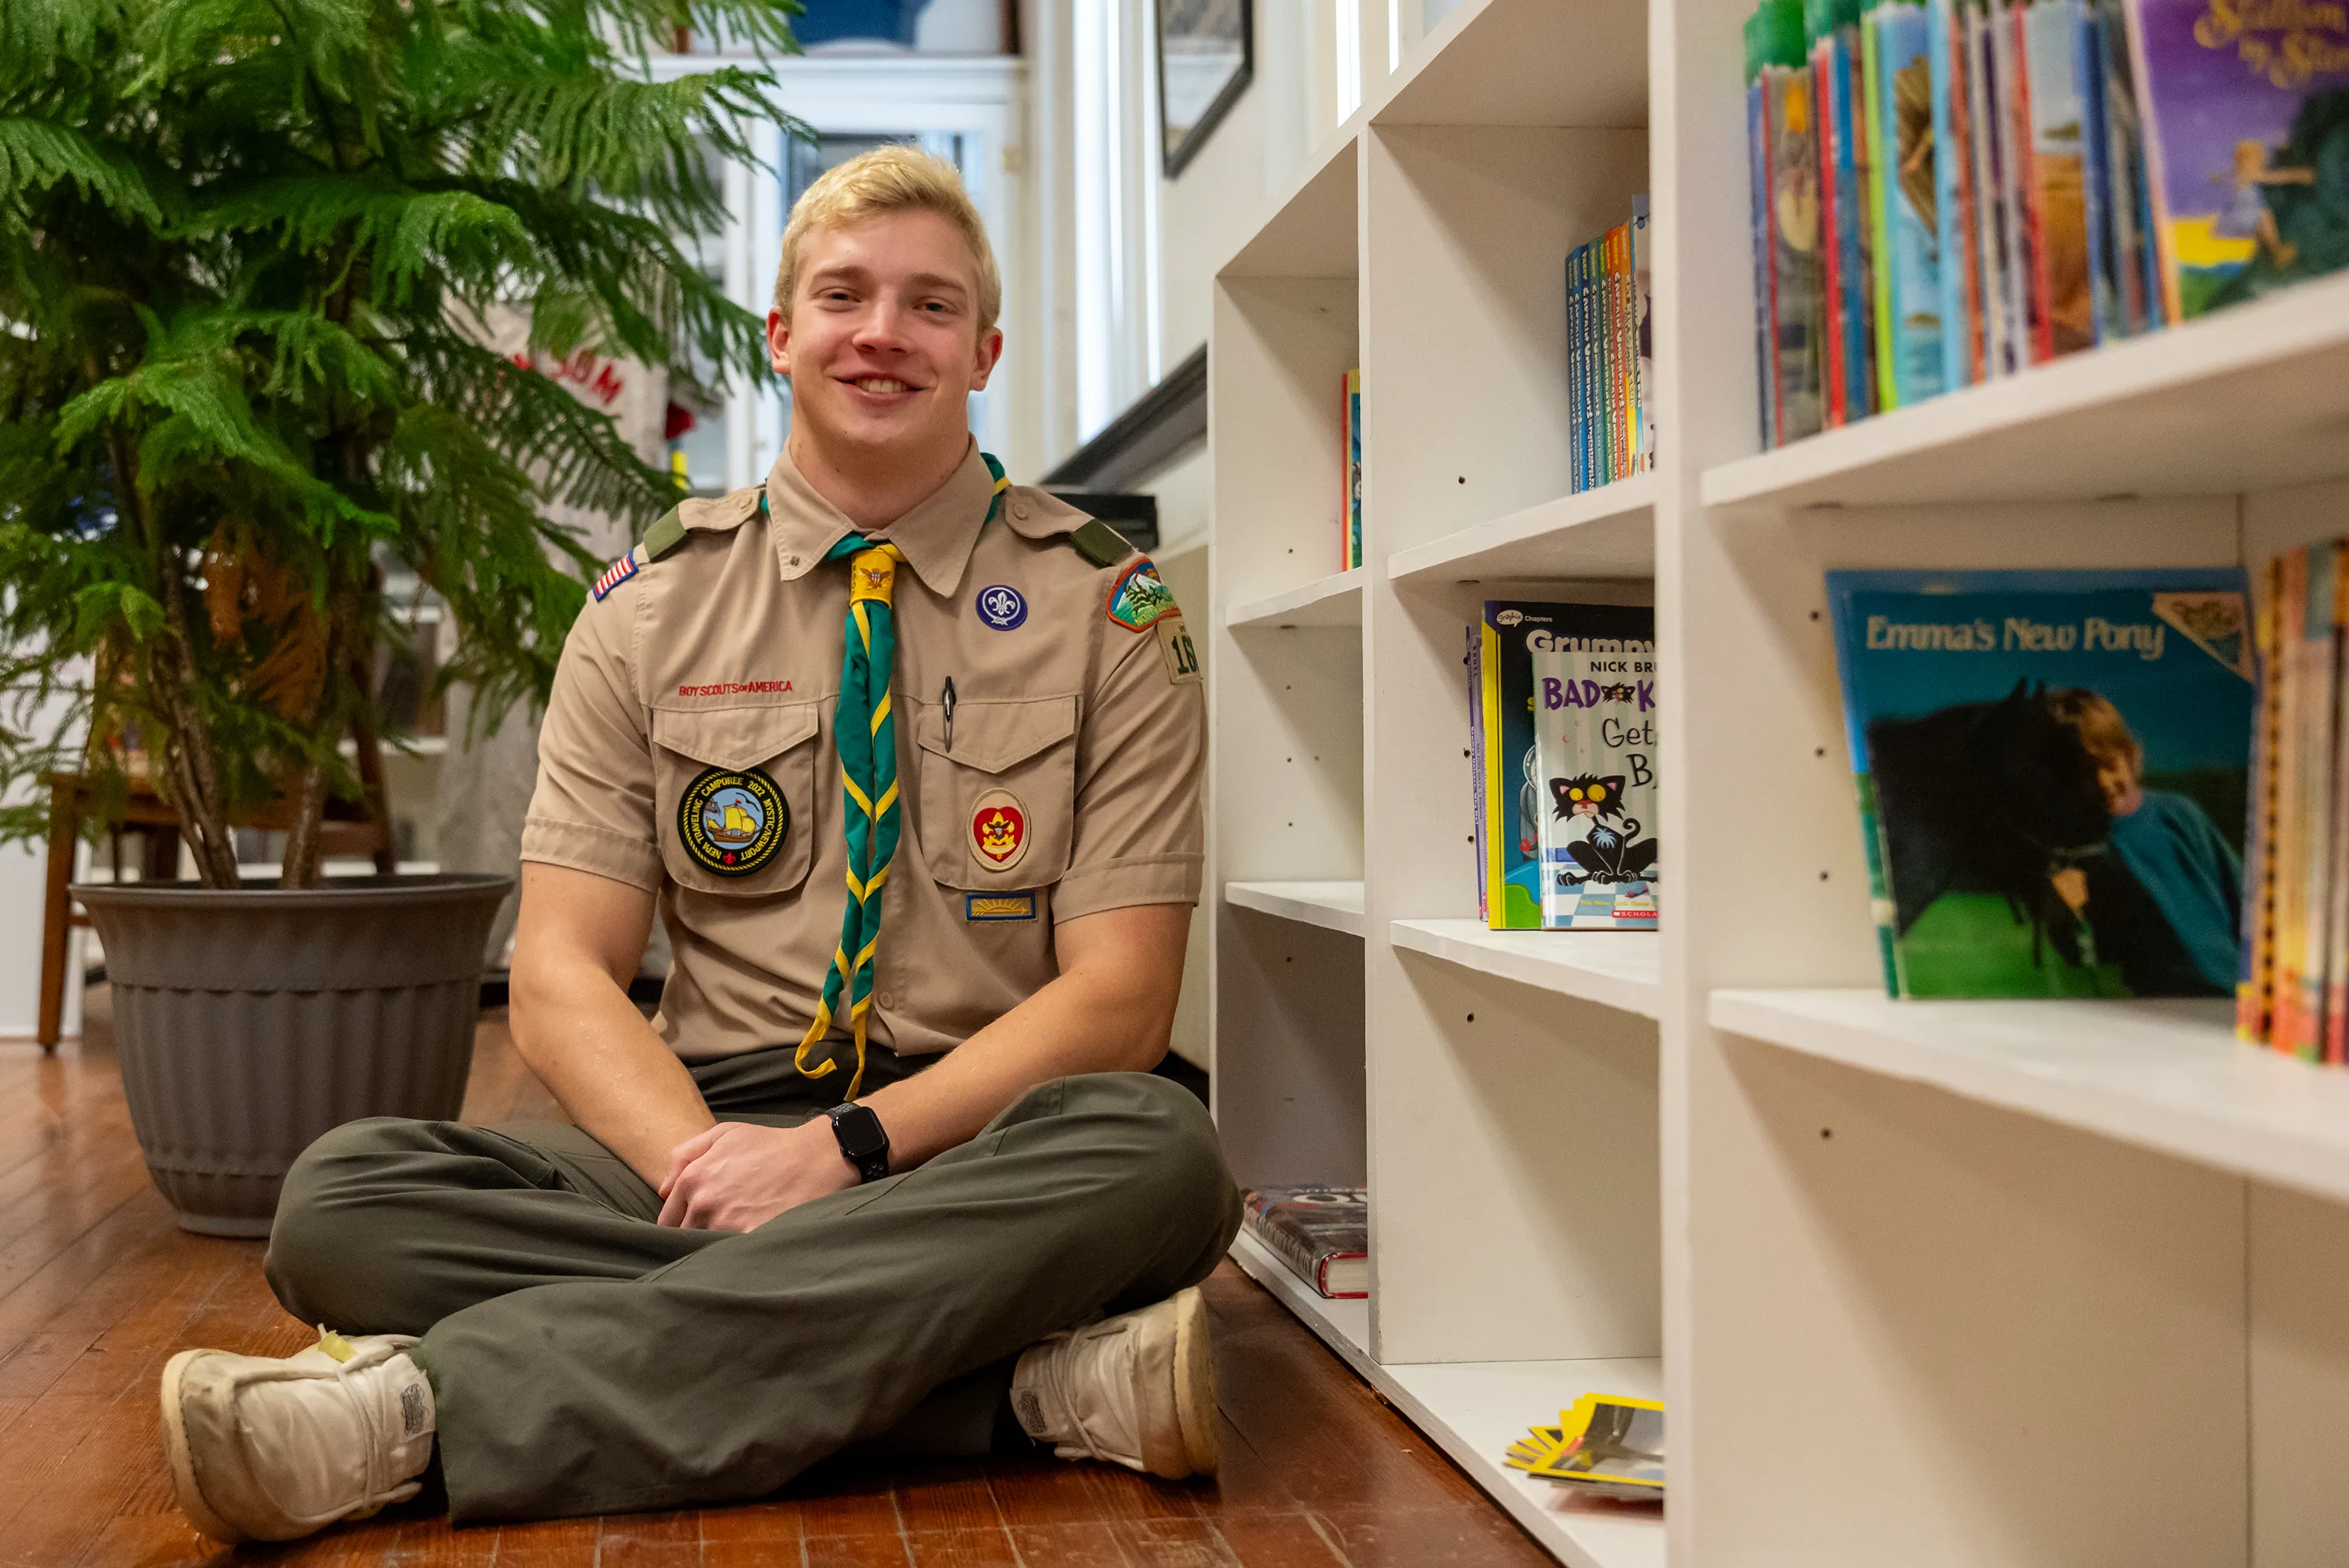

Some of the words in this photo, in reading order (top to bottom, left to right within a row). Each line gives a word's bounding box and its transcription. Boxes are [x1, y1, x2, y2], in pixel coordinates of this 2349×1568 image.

[1584, 342, 1593, 420] UNDERPANTS
[1867, 615, 1997, 651] Emma's
[2001, 616, 2077, 651] New
[2083, 616, 2165, 661] Pony
[1590, 661, 1628, 672] NICK
[1634, 662, 1656, 673] BR
[679, 686, 698, 697] BOY
[699, 683, 739, 696] SCOUTS
[748, 680, 792, 693] AMERICA
[1542, 677, 1600, 711] BAD
[1626, 754, 1656, 789] B
[701, 777, 744, 797] CAMPOREE
[747, 780, 766, 797] 2022
[691, 798, 705, 844] TRAVELING
[702, 842, 722, 860] NEPA
